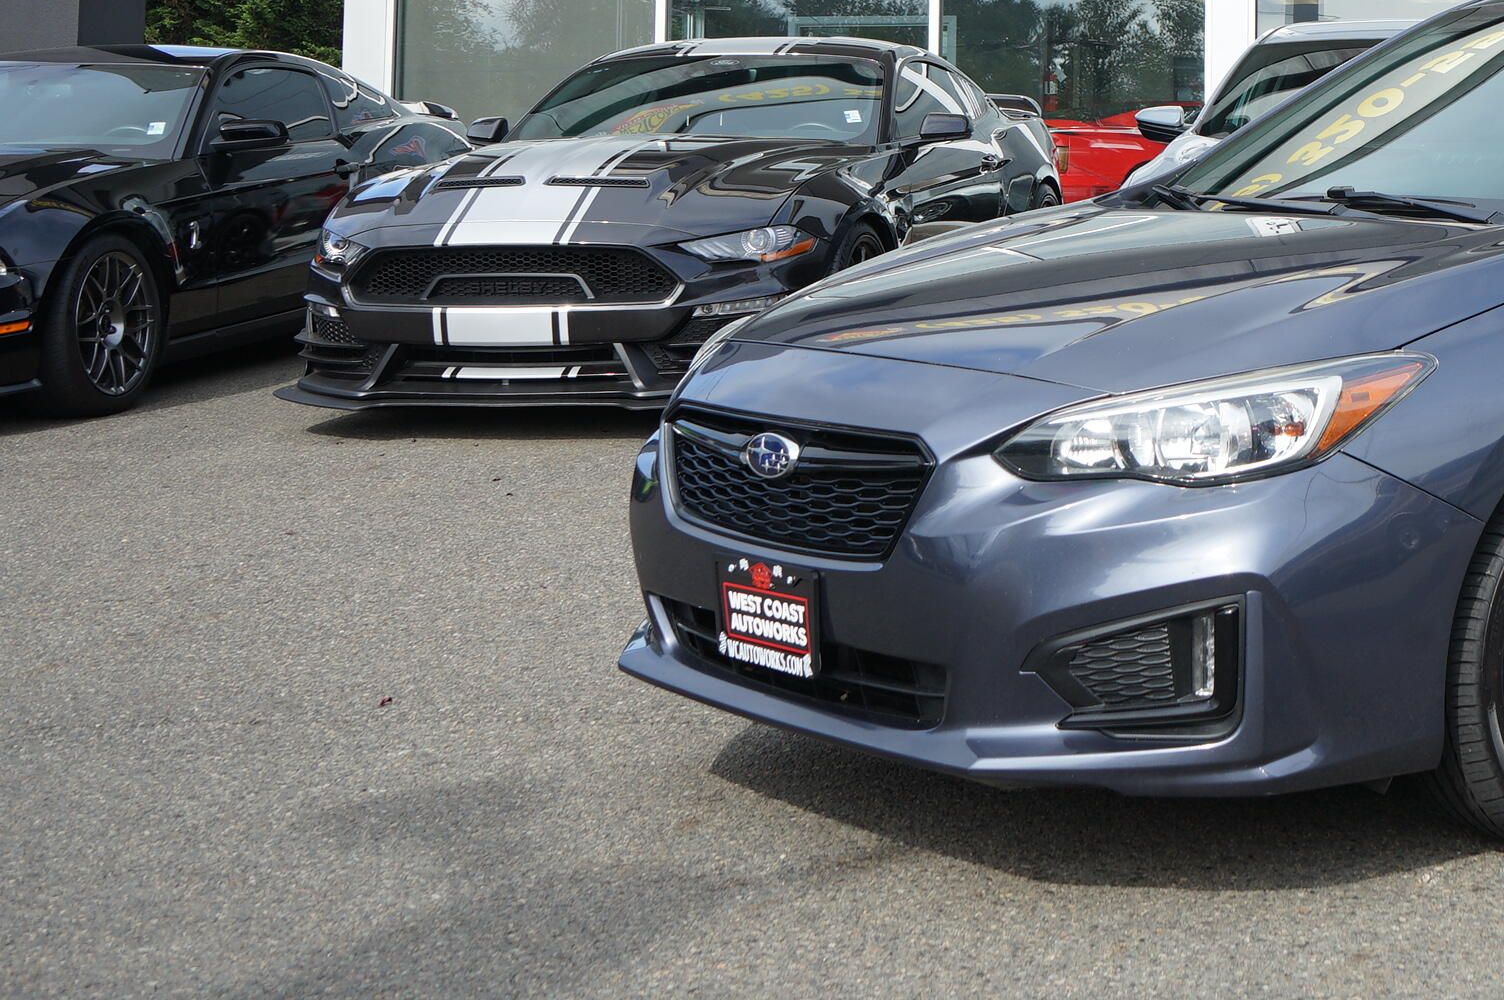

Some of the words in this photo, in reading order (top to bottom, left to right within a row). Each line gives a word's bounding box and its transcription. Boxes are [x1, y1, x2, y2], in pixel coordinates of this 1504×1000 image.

[727, 590, 762, 614] WEST
[763, 598, 805, 624] COAST
[731, 612, 808, 647] AUTOWORKS
[727, 638, 804, 677] WCAUTOWORKS.COM
